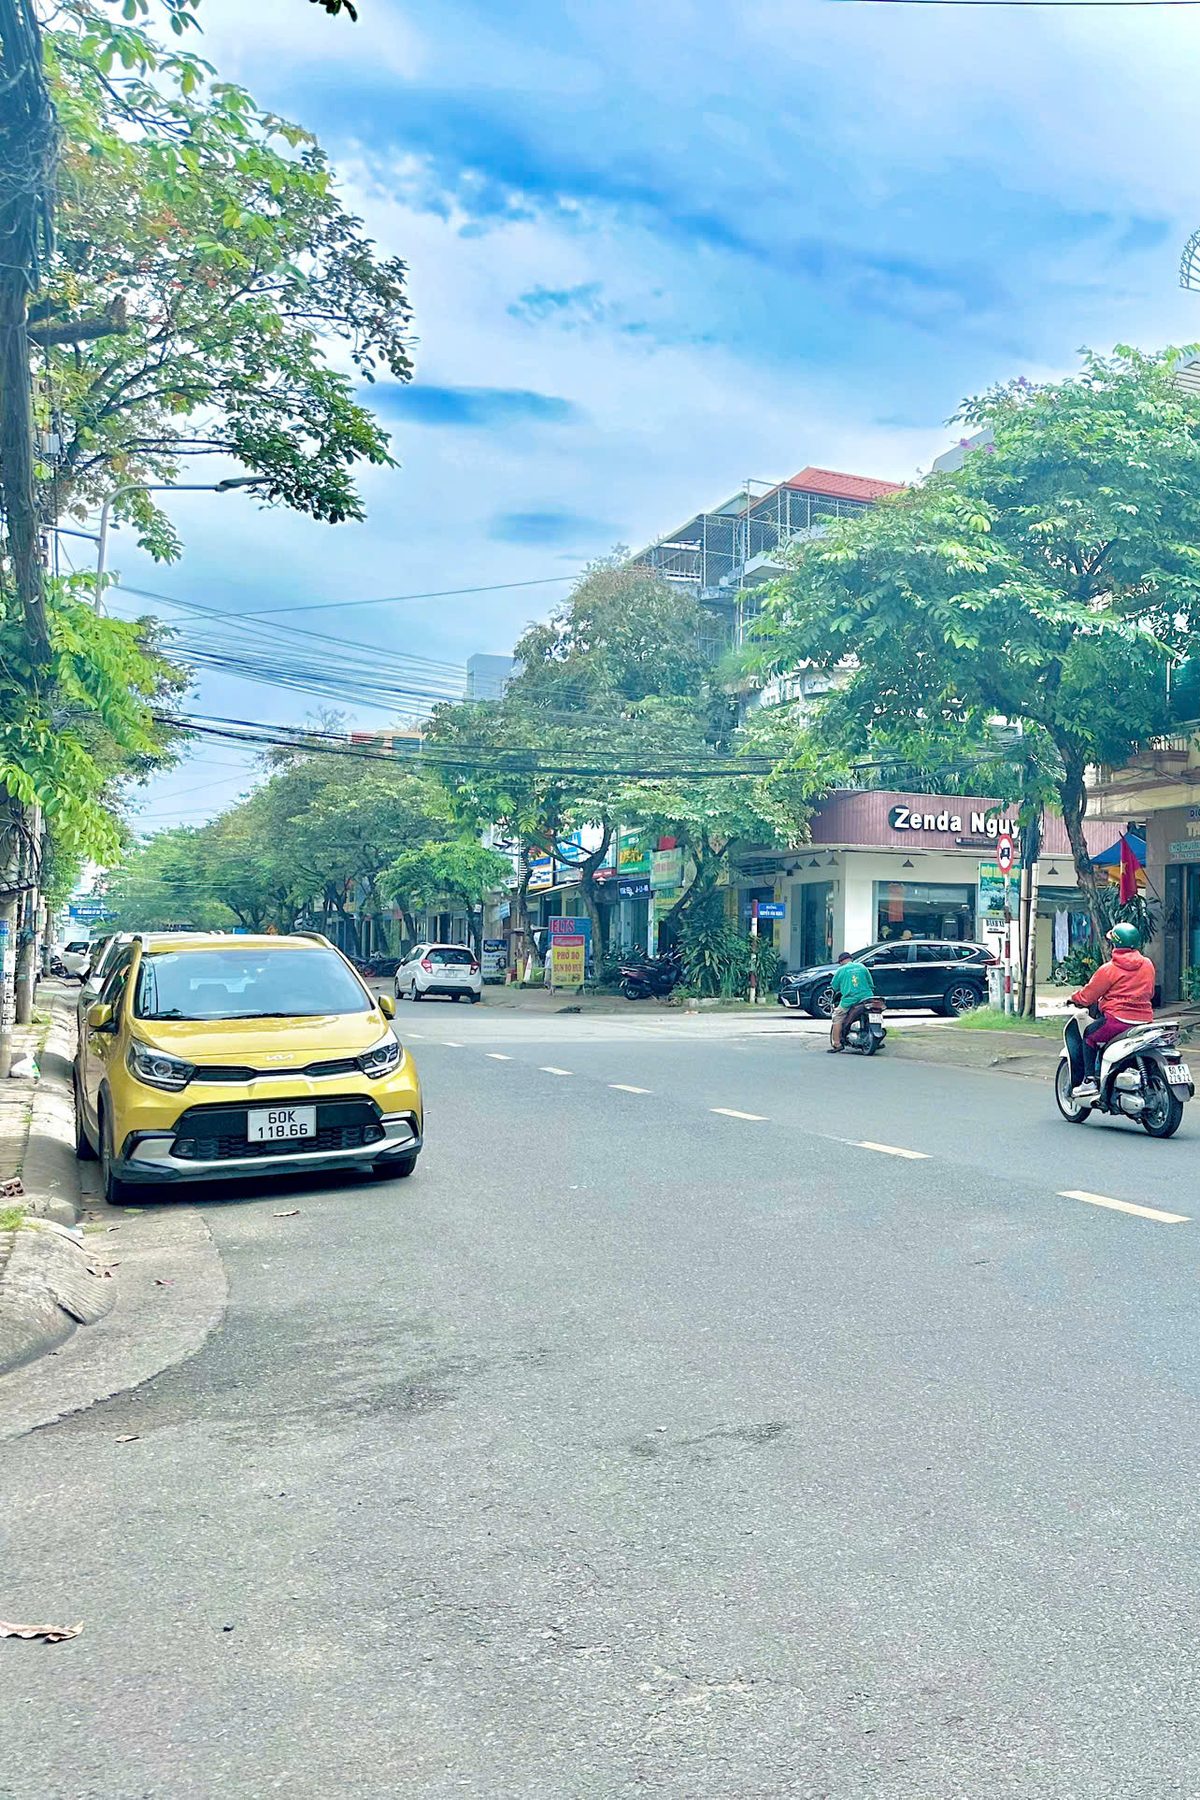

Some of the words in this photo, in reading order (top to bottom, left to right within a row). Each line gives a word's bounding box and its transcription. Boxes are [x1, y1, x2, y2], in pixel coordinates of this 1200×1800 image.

[894, 808, 962, 832] Zenda
[971, 812, 1022, 839] Nguy
[550, 919, 576, 933] IELTS
[268, 1111, 296, 1124] 60K
[258, 1123, 308, 1139] 118.66
